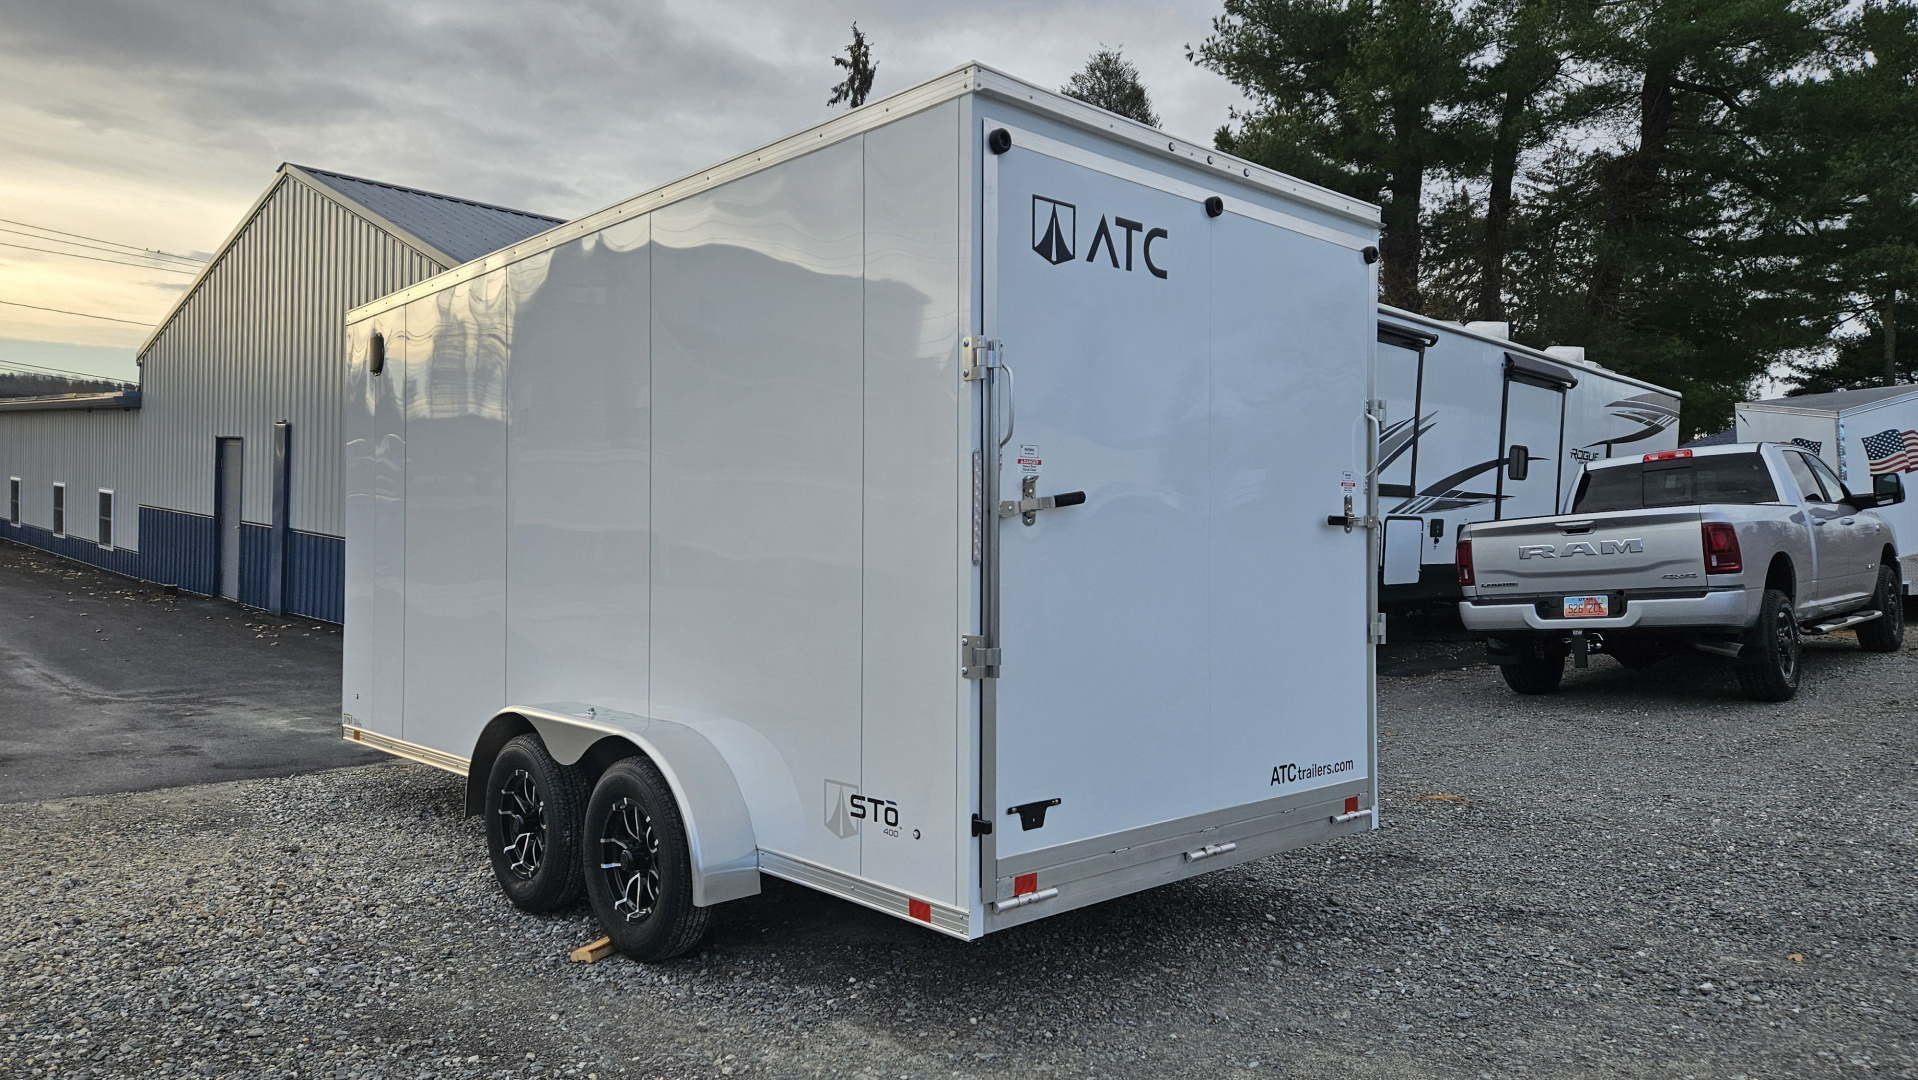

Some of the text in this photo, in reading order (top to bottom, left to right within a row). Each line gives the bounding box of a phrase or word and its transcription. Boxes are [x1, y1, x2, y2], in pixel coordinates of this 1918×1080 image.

[1086, 213, 1168, 280] ATC
[1570, 448, 1599, 461] ROGUE
[1518, 537, 1644, 560] RAM
[883, 828, 899, 838] 400
